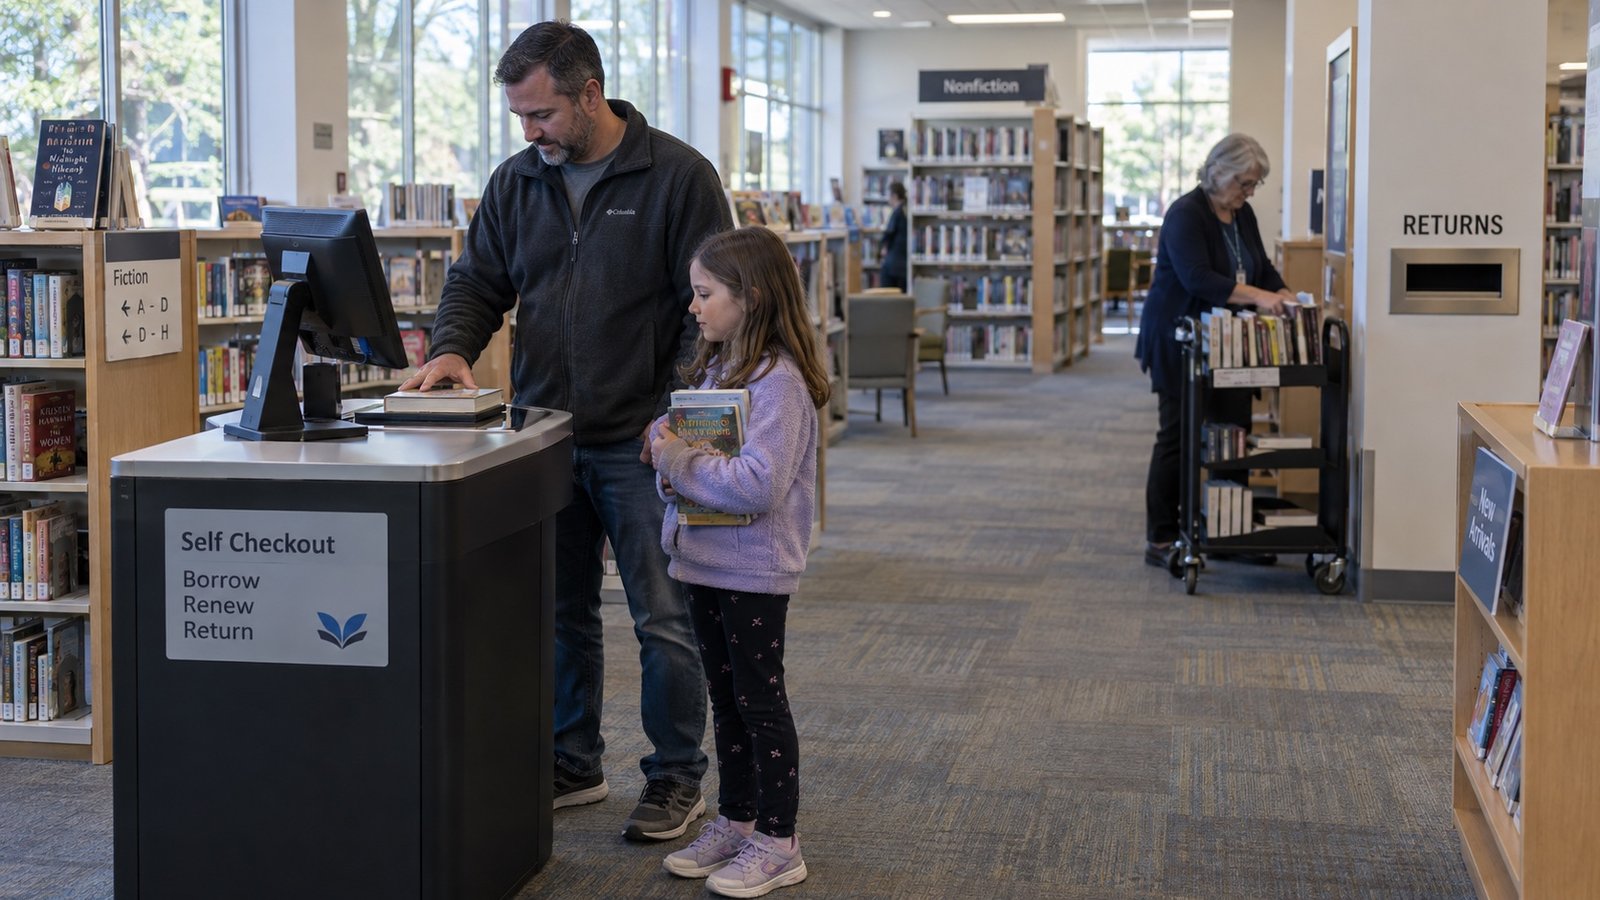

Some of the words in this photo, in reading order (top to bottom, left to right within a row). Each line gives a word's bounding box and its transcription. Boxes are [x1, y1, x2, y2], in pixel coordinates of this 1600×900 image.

[943, 78, 1020, 94] Nonfiction
[1403, 214, 1504, 236] RETURNS
[113, 268, 149, 286] Fiction
[137, 298, 146, 315] A
[160, 296, 169, 313] D
[138, 326, 147, 343] D
[161, 324, 169, 340] H
[1478, 487, 1496, 522] New
[181, 531, 223, 552] Self
[229, 532, 336, 554] Checkout
[1468, 516, 1496, 563] Arrivals
[183, 570, 261, 589] Borrow
[183, 595, 255, 614] Renew
[184, 621, 253, 640] Return
